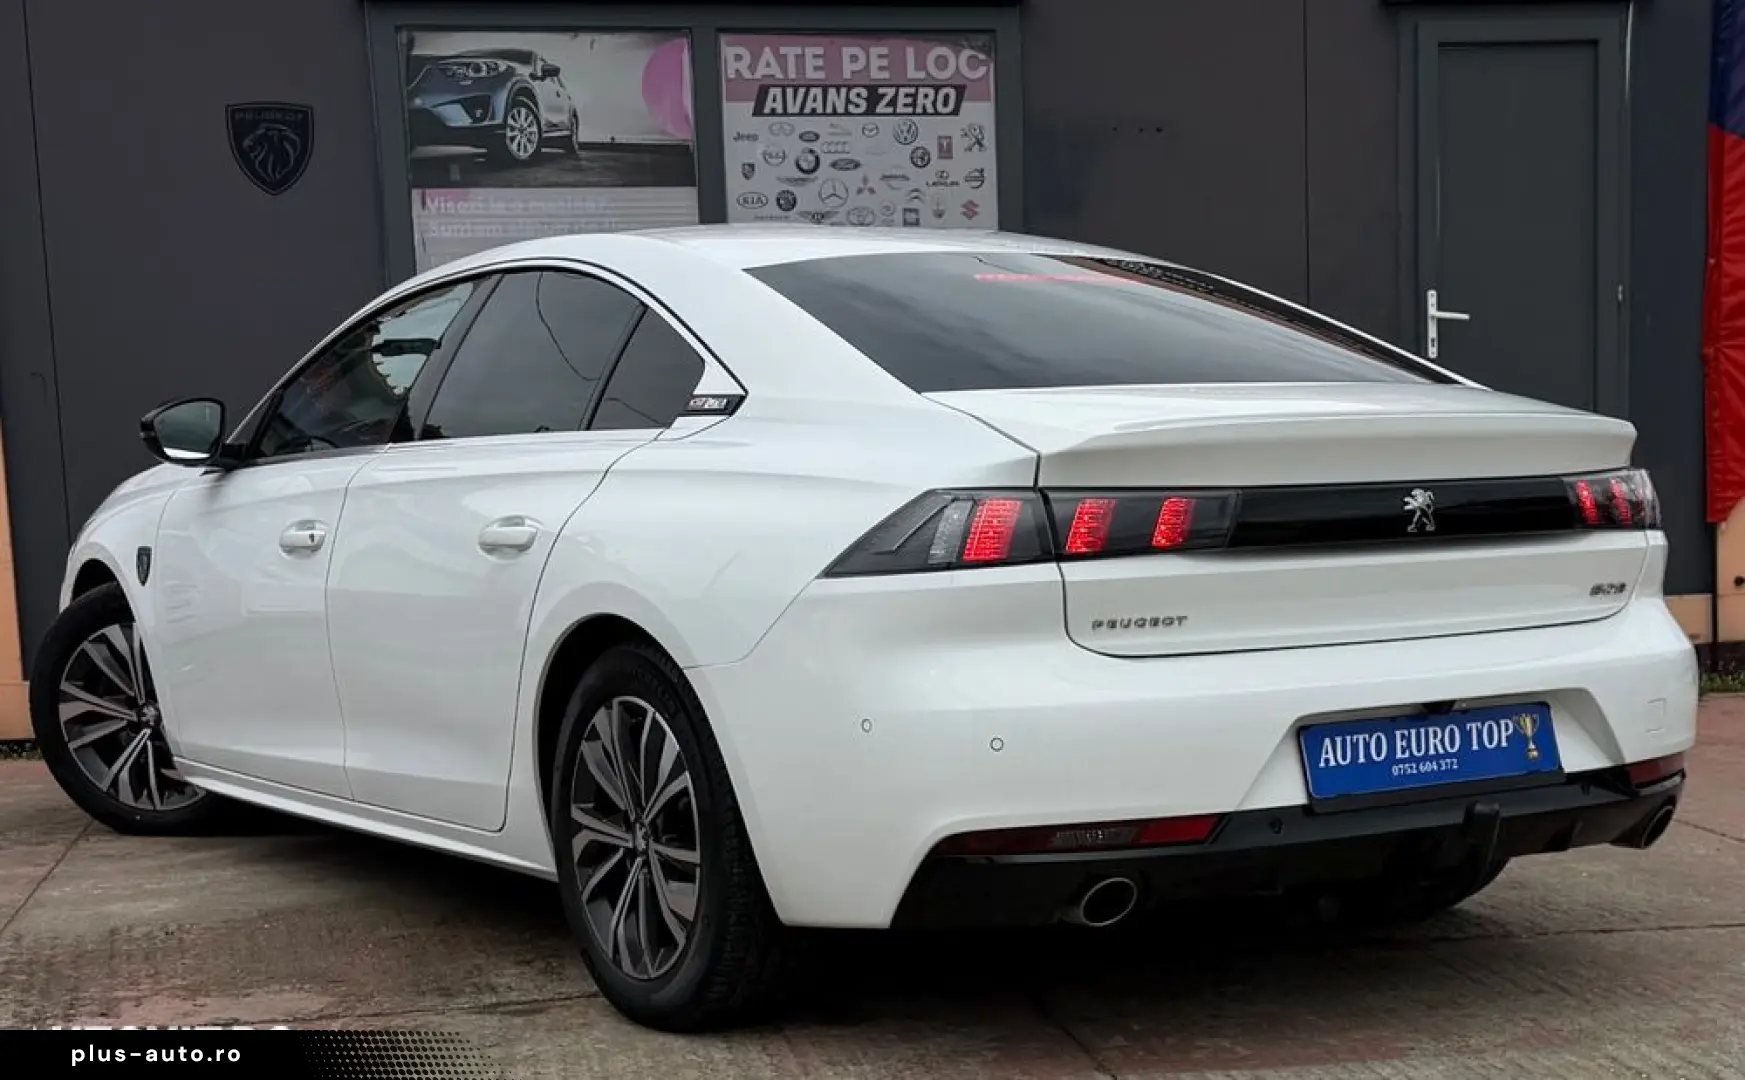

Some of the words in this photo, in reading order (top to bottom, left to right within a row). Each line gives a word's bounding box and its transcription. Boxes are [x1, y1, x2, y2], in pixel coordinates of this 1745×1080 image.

[726, 46, 825, 80] RATE
[842, 46, 889, 80] PE
[906, 45, 988, 80] LOC
[763, 87, 868, 114] AVANS
[875, 87, 957, 114] ZERO
[1091, 615, 1188, 630] PEUGEOT
[1318, 732, 1388, 768] AUTO
[1394, 723, 1461, 759] EURO
[1466, 718, 1514, 750] TOP
[1391, 762, 1418, 776] 0752
[1419, 760, 1438, 773] 604
[1439, 758, 1459, 771] 372
